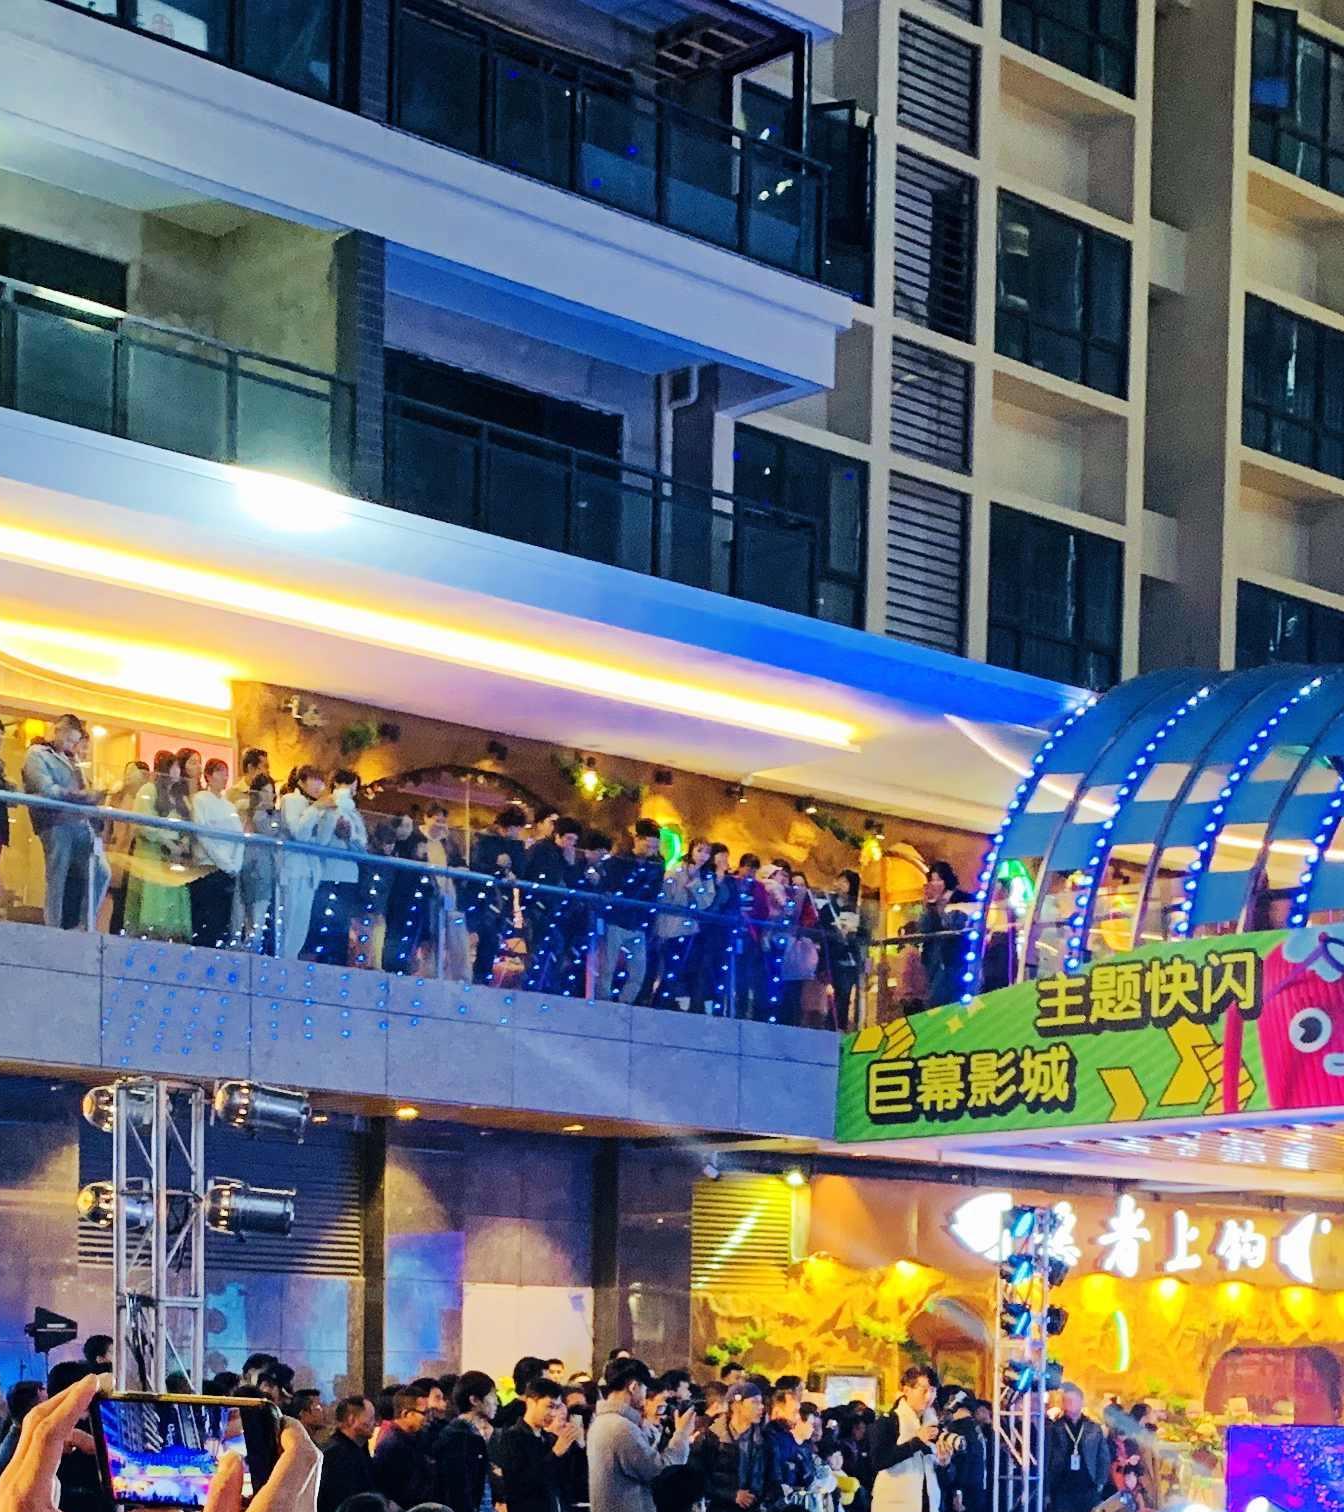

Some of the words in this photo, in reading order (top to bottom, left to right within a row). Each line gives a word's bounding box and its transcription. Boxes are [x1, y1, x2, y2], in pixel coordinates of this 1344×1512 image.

[1034, 950, 1258, 1029] 主题快闪
[867, 1043, 1073, 1116] 巨幕影城
